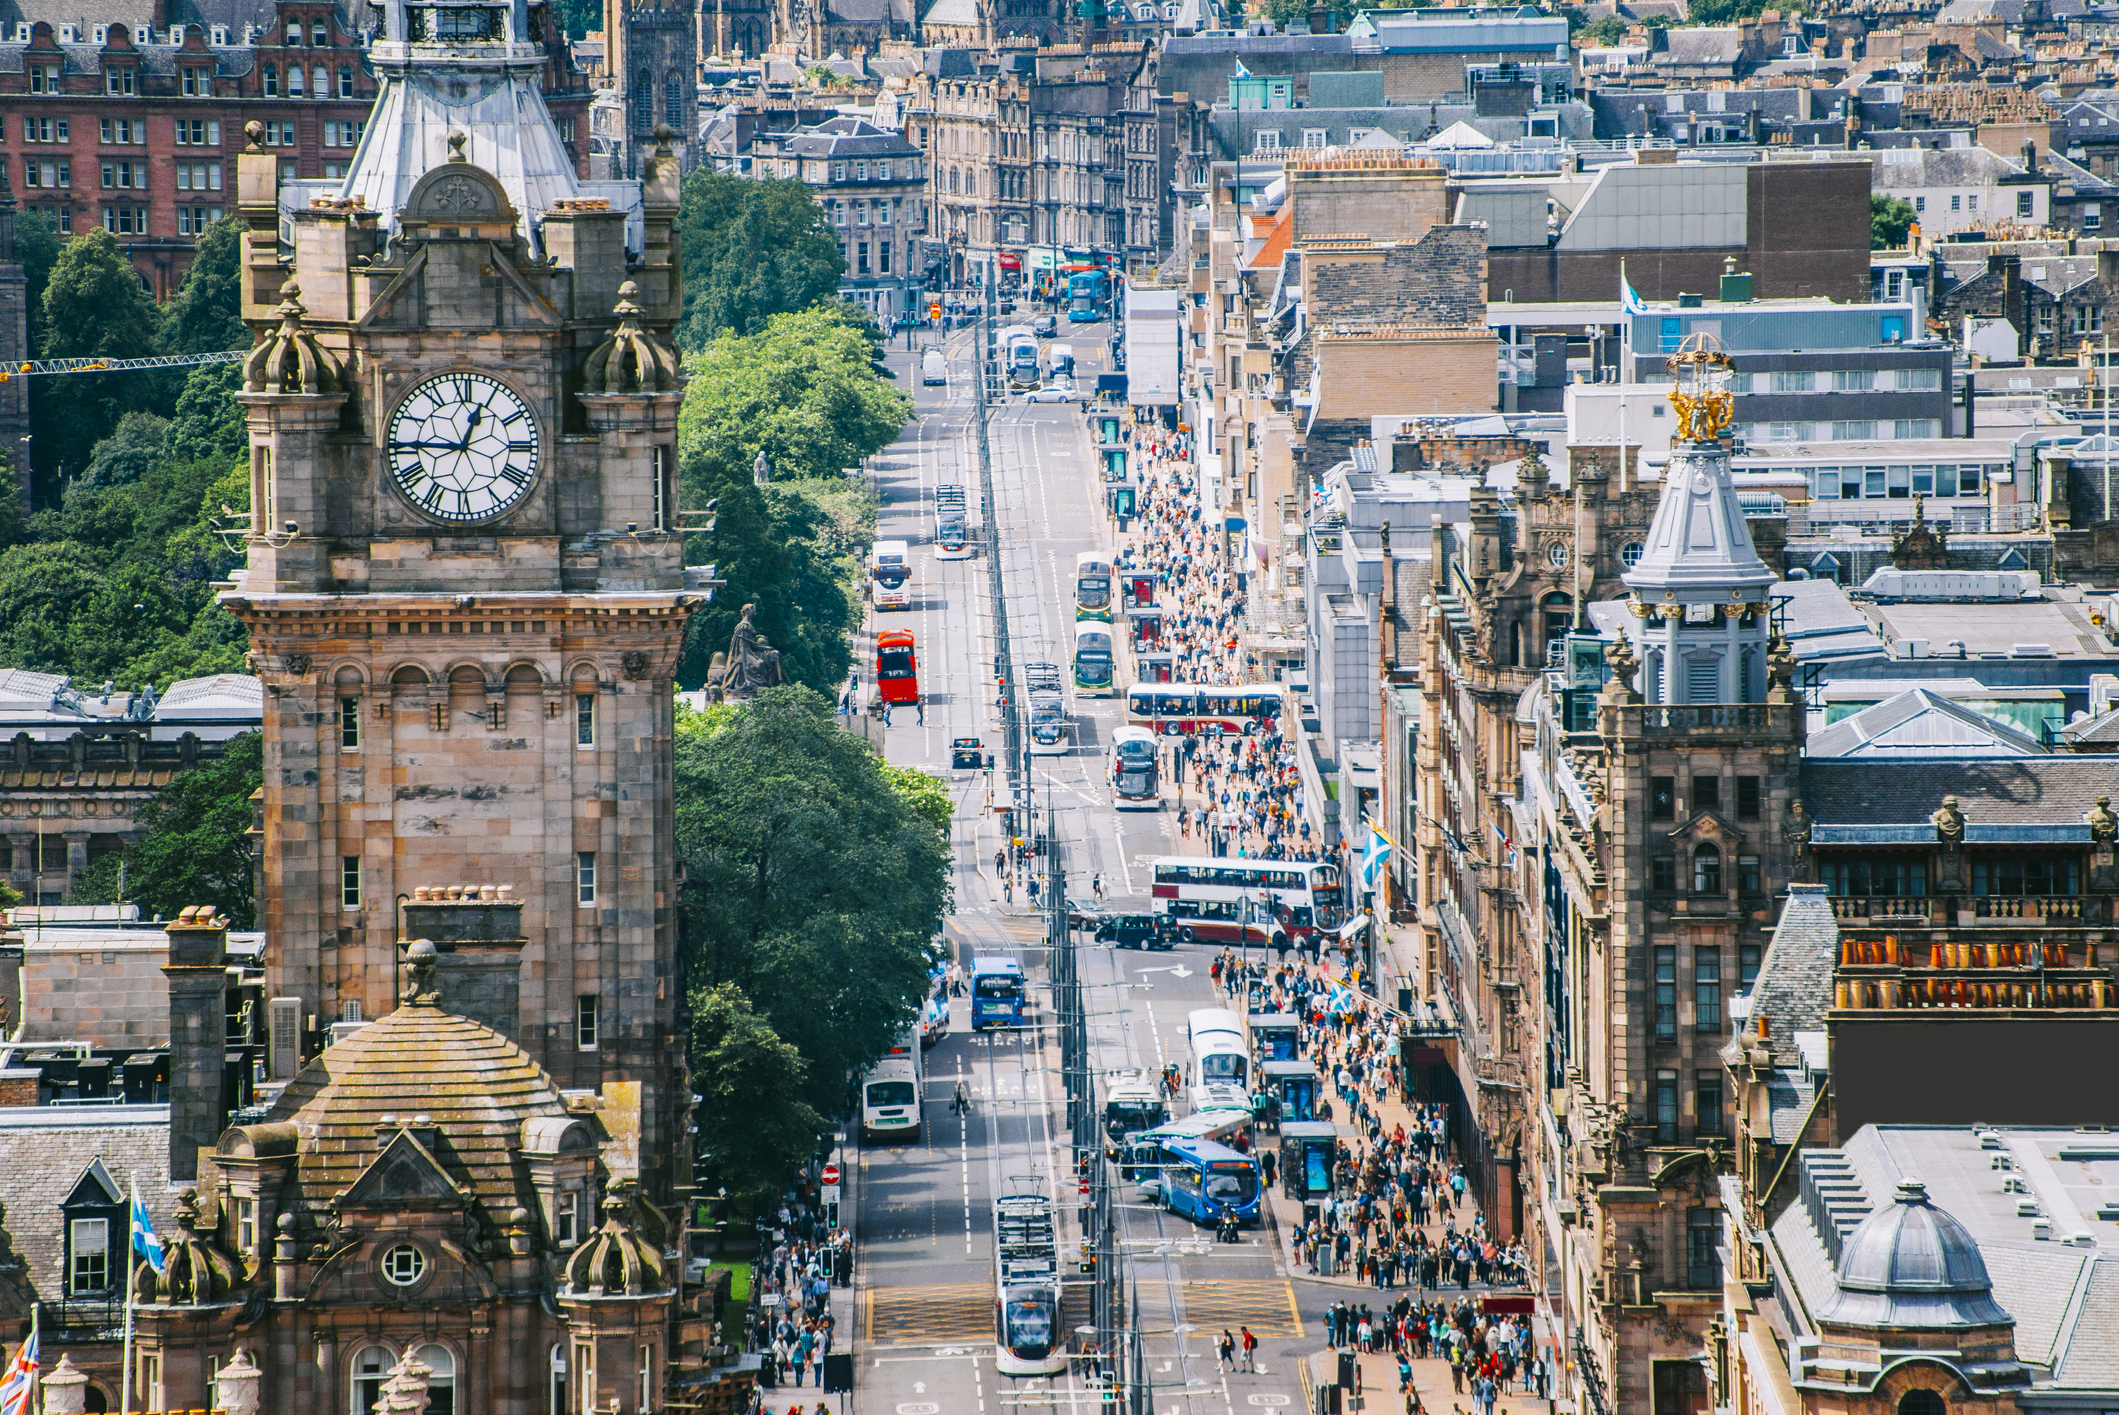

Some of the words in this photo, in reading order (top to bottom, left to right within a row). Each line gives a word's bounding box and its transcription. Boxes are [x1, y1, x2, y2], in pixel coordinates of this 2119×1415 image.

[423, 386, 446, 411] XI
[453, 380, 473, 402] XII
[486, 388, 499, 408] I
[402, 410, 426, 428] X
[502, 410, 524, 427] II
[509, 440, 532, 453] III
[400, 461, 427, 487] VIII
[424, 483, 446, 509] VII
[457, 492, 471, 514] VI
[487, 486, 503, 506] V
